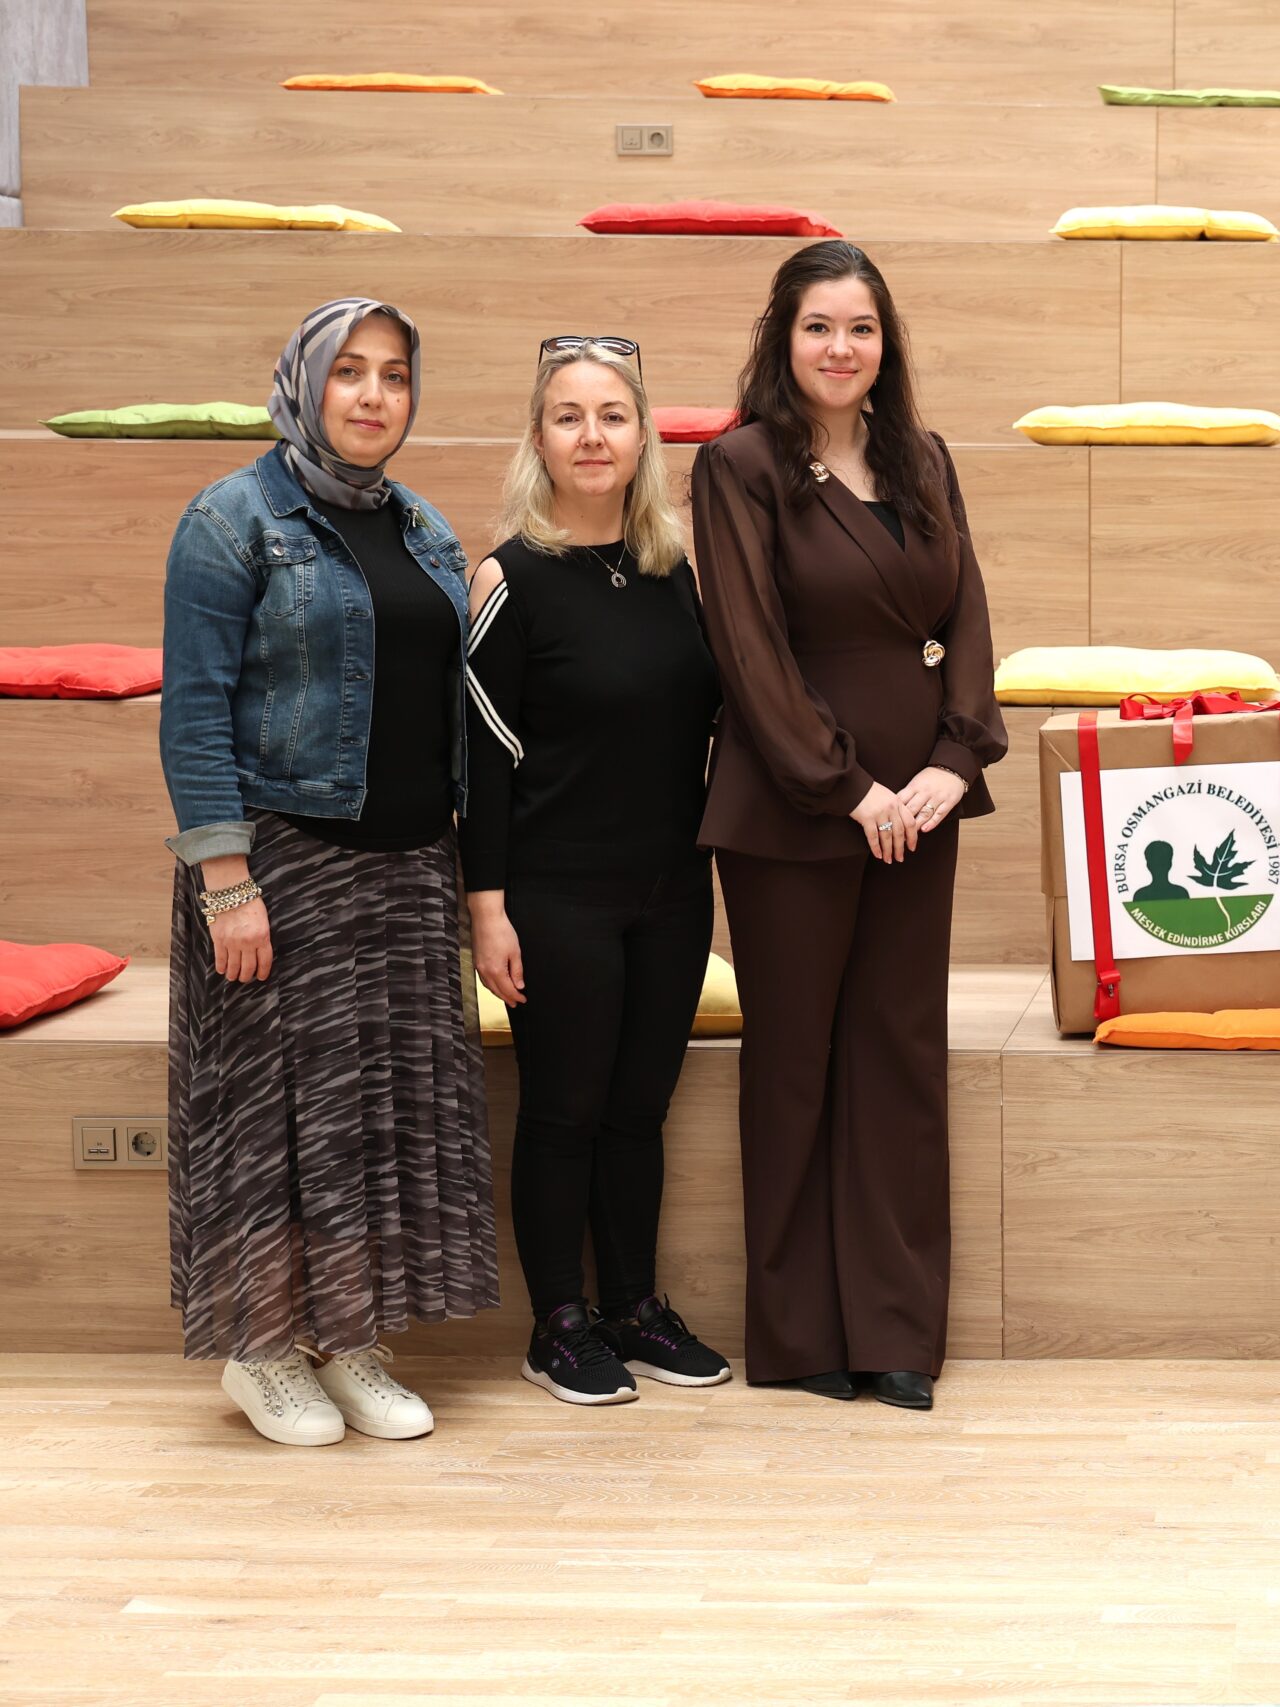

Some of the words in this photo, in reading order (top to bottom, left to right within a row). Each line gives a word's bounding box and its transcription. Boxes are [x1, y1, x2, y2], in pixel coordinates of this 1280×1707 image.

[1121, 779, 1203, 839] OSMANGAZİ
[1206, 782, 1280, 851] BELEDİYESİ
[1114, 843, 1130, 894] BURSA
[1267, 854, 1280, 886] 1987
[1130, 906, 1167, 939] MESLEK
[1166, 932, 1225, 947] EDİNDİRME
[1224, 900, 1268, 941] KURSLARI
